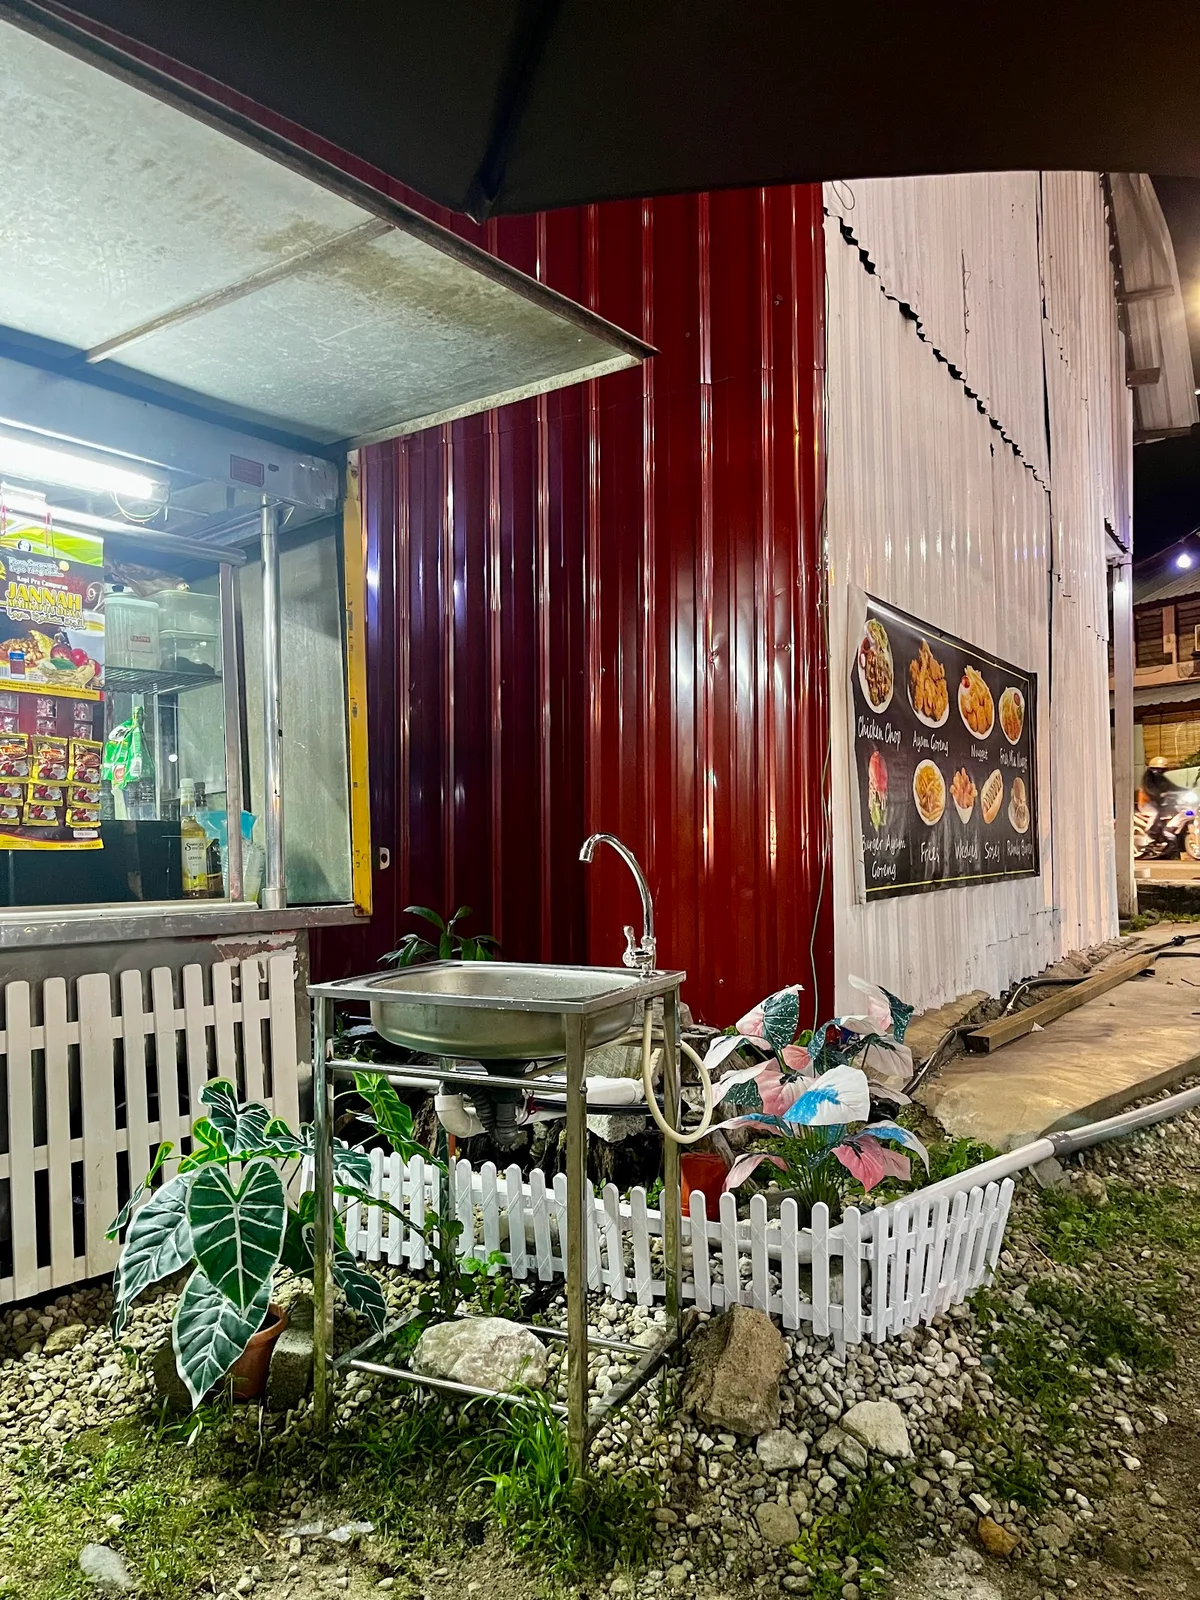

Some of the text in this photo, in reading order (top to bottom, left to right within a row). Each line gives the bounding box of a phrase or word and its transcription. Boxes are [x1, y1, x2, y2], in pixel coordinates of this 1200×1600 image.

[6, 581, 83, 611] JANNAH
[857, 714, 902, 752] Chicken Chop
[912, 730, 949, 757] Ayam Goreng
[970, 743, 988, 763] Nugget
[861, 834, 906, 856] Burger Ayam
[920, 841, 940, 863] Fries
[954, 838, 978, 864] Wedges
[984, 840, 1001, 863] Sosej
[871, 860, 897, 881] Goreng
